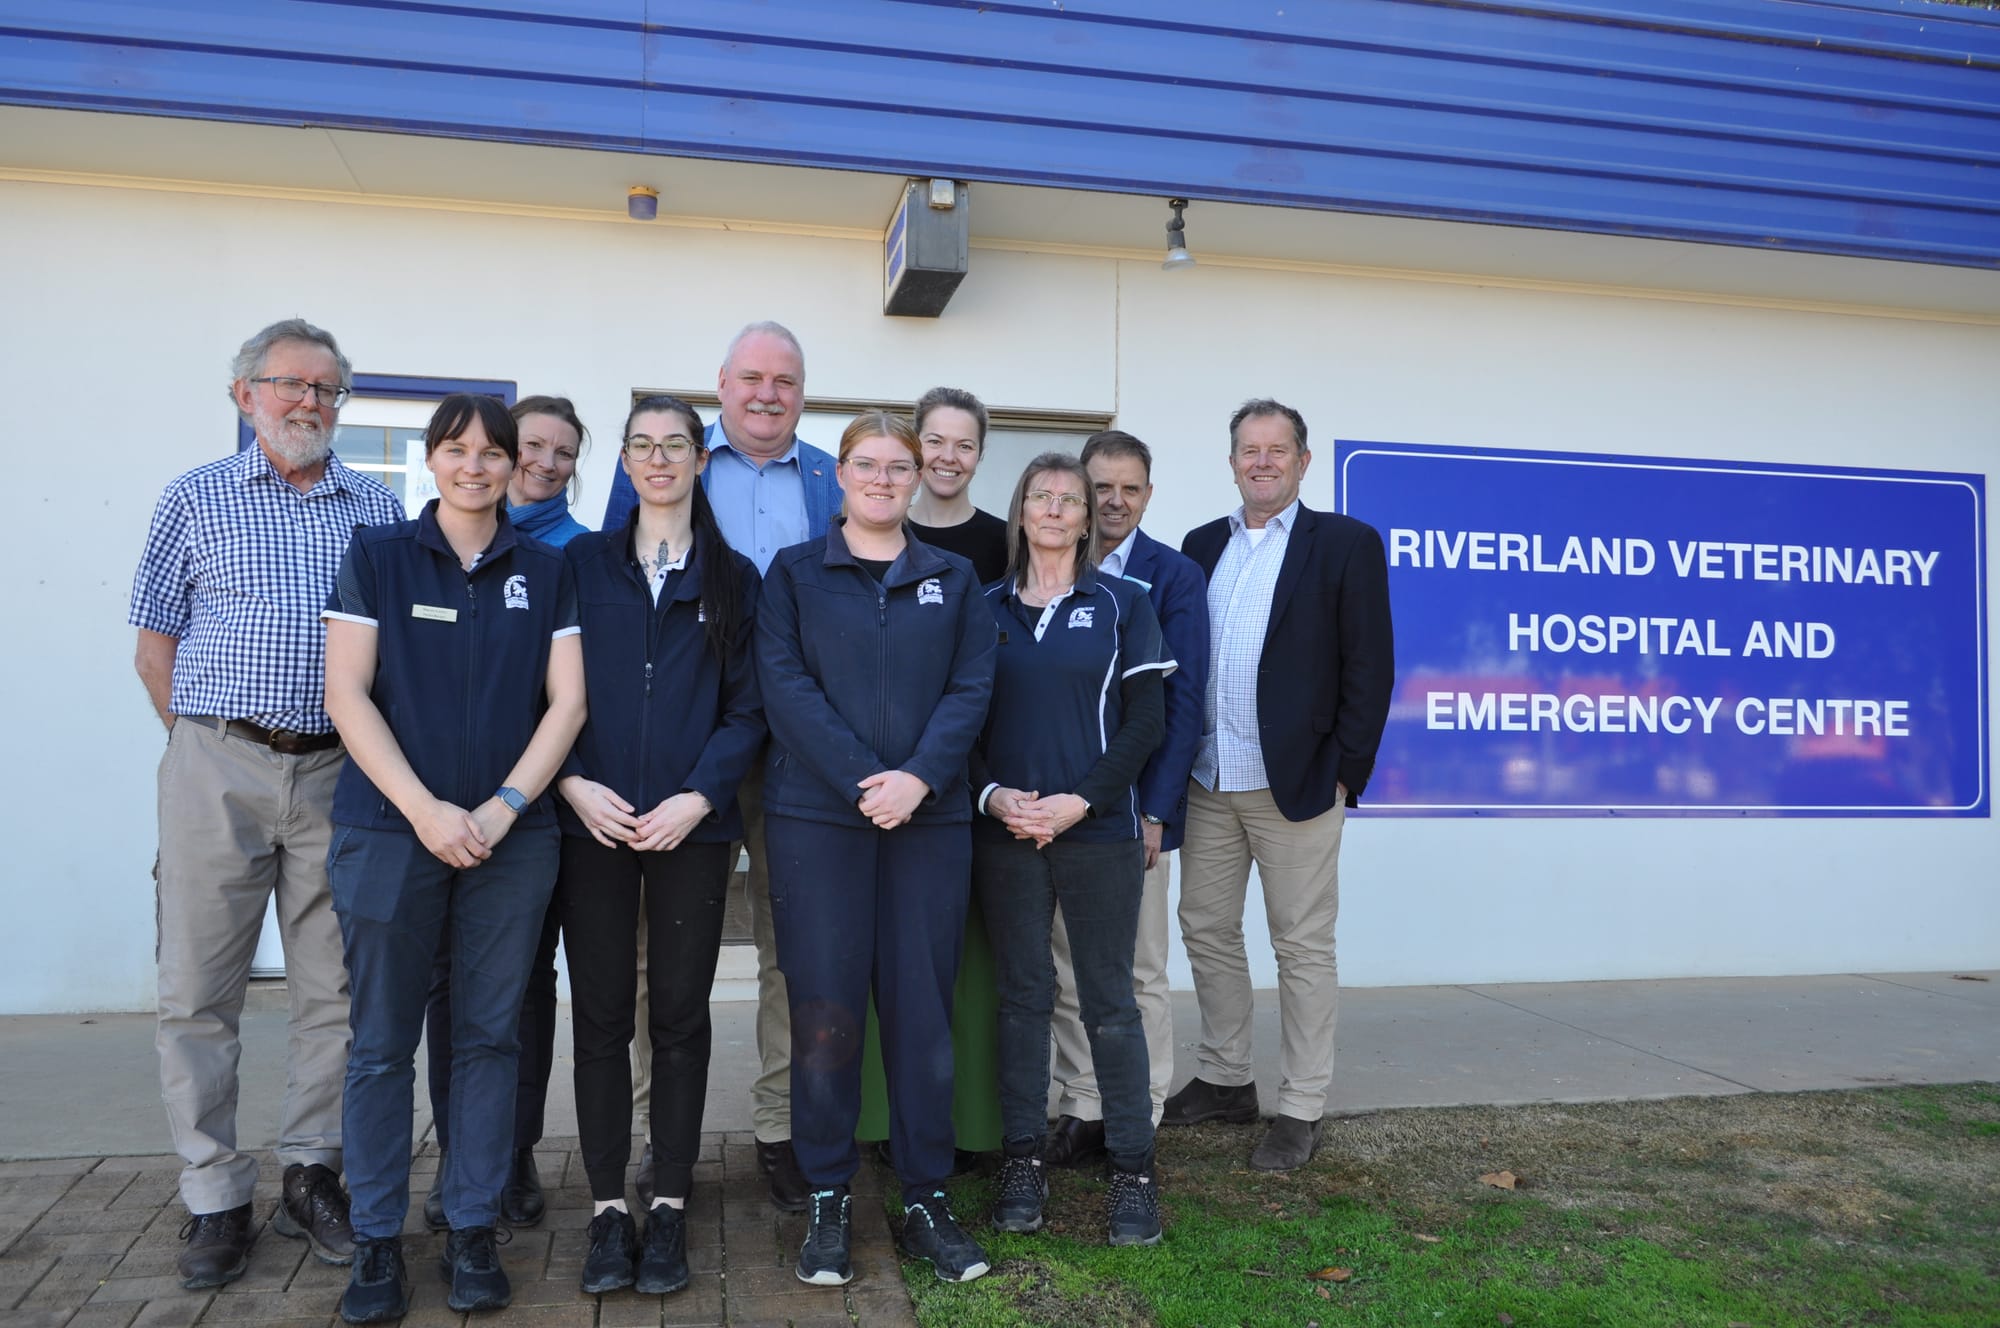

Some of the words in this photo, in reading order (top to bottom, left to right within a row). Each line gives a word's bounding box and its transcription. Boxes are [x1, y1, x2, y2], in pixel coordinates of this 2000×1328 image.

[1389, 528, 1657, 577] RIVERLAND
[1668, 540, 1940, 587] VETERINARY
[1508, 612, 1732, 658] HOSPITAL
[1742, 620, 1837, 660] AND
[1425, 690, 1724, 735] EMERGENCY
[1734, 697, 1911, 738] CENTRE
